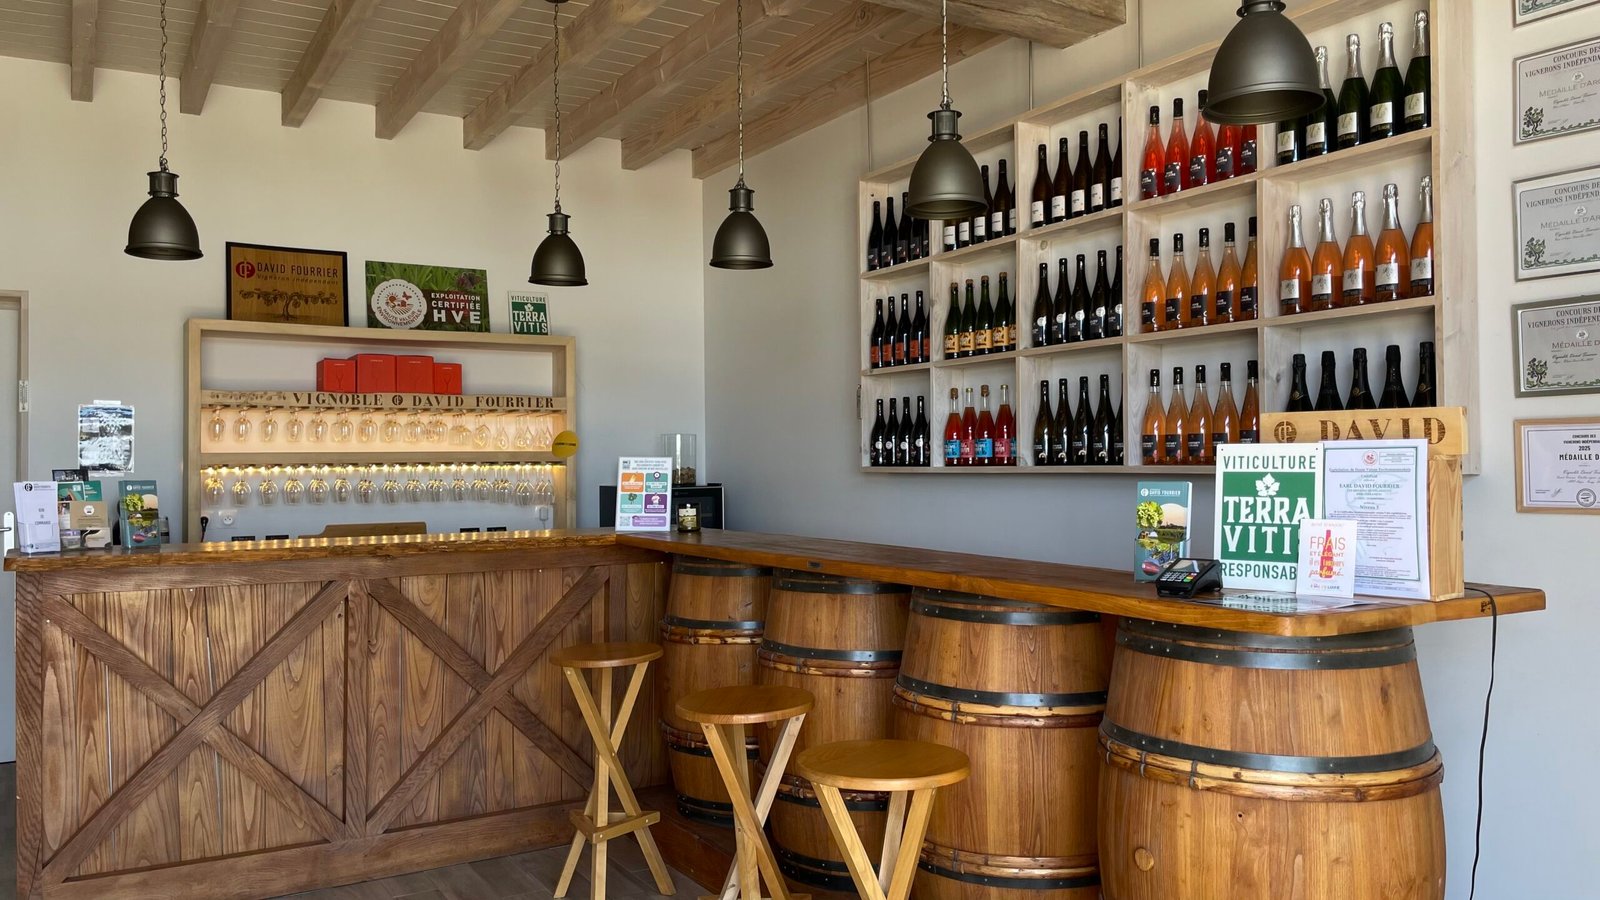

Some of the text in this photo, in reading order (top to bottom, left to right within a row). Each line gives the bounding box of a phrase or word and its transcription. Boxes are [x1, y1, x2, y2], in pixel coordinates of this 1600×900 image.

[1553, 48, 1587, 63] CONCOURS
[1524, 64, 1562, 78] VIGNERONS
[1554, 183, 1590, 195] CONCOURS
[1526, 196, 1563, 208] VIGNERONS
[257, 262, 338, 278] DAVID FOURRIER
[431, 292, 481, 301] EXPLOITATION
[511, 295, 546, 303] VITICULTURE
[431, 301, 481, 311] CERTIFIÉE
[1556, 306, 1592, 318] CONCOURS
[513, 310, 547, 322] TERRA
[513, 321, 548, 333] VITIS
[1528, 318, 1565, 329] VIGNERONS
[1552, 340, 1593, 349] MÉDAILLE
[293, 393, 554, 409] VIGNOBLE DAVID FOURRIER
[1319, 417, 1446, 444] DAVID
[1223, 455, 1316, 470] VITICULTURE
[1559, 453, 1593, 461] MÉDAILLE
[1223, 496, 1311, 525] TERRA
[1223, 525, 1300, 555] VITI
[1310, 536, 1346, 551] FRAIS
